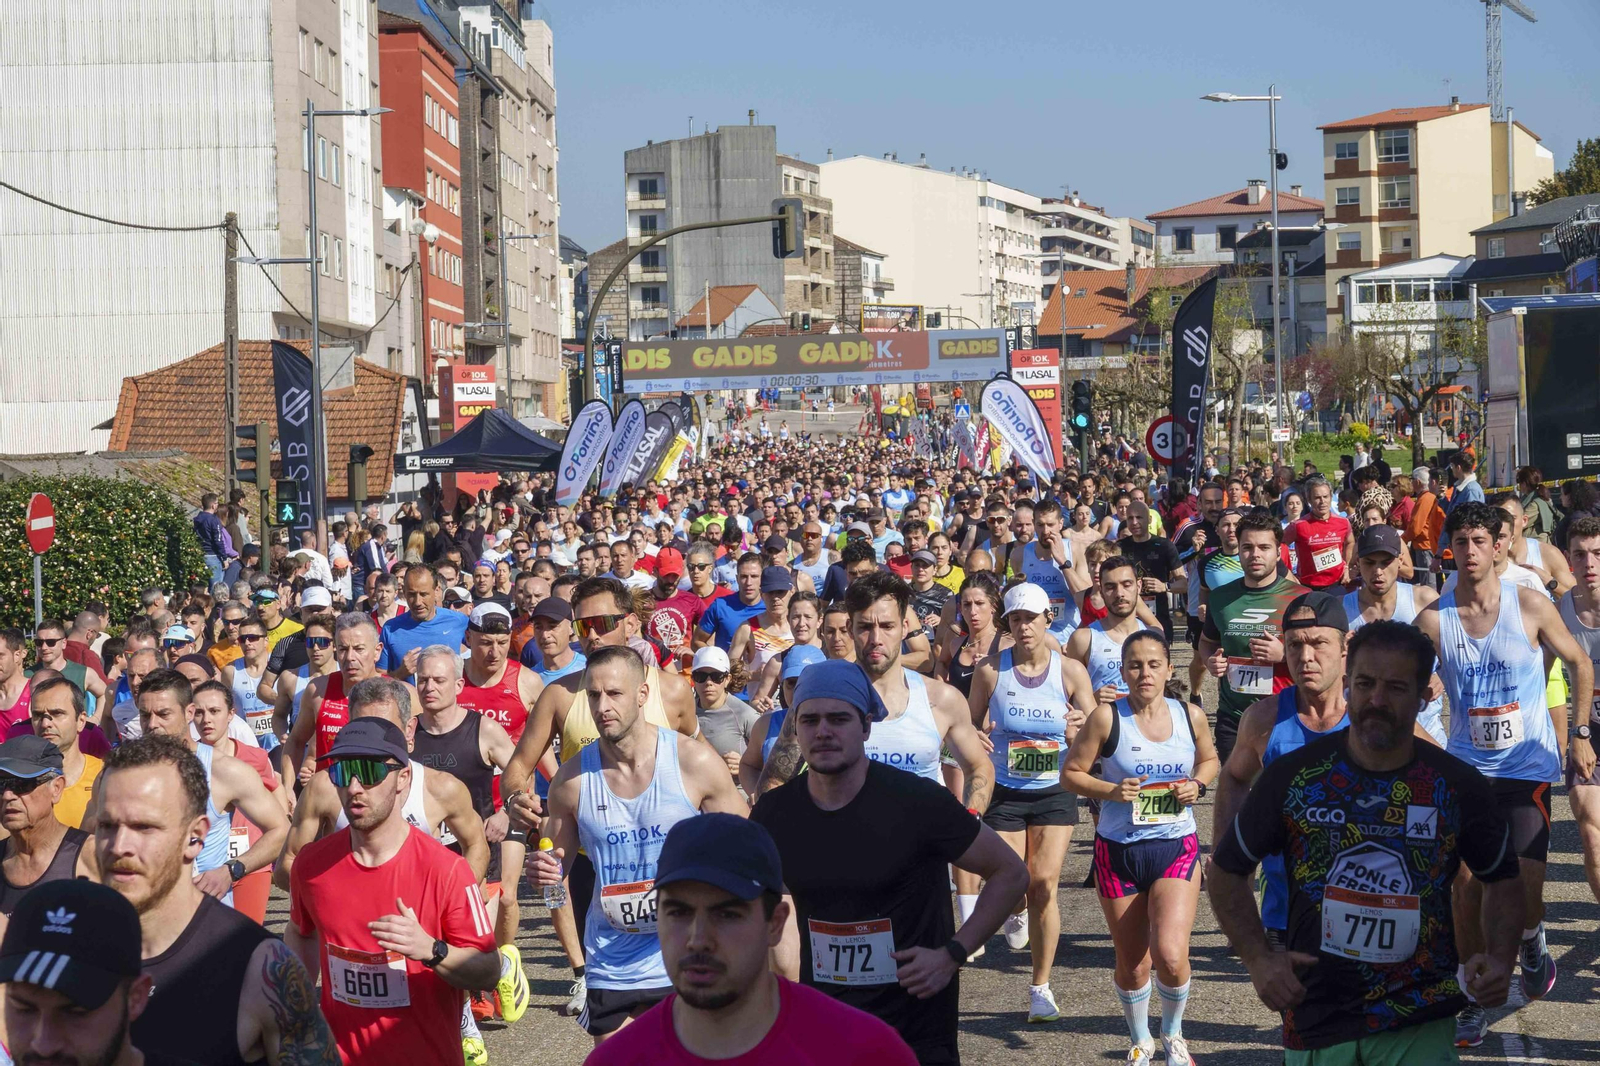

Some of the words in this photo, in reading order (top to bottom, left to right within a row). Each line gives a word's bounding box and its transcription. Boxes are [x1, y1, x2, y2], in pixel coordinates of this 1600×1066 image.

[692, 344, 778, 368] GADIS
[941, 340, 998, 356] GADIS
[622, 348, 672, 370] DIS
[770, 375, 819, 387] 00:00:30
[1025, 370, 1055, 379] LASAL
[466, 386, 492, 395] LASAL
[1028, 388, 1055, 400] ADIS
[570, 411, 604, 466] Porriño
[612, 410, 639, 460] Porriño
[1156, 432, 1185, 449] 30
[628, 426, 665, 475] LASAL
[1320, 553, 1336, 566] 823
[1239, 670, 1258, 687] 771
[1483, 720, 1512, 741] 373
[422, 753, 457, 769] FILA
[1016, 754, 1053, 771] 2068
[1409, 822, 1431, 836] AXA
[1343, 861, 1401, 893] PONLE
[1360, 908, 1383, 916] LEMOS
[42, 925, 73, 934] adidas
[1345, 913, 1396, 949] 770
[829, 944, 874, 972] 772
[344, 969, 388, 997] 660
